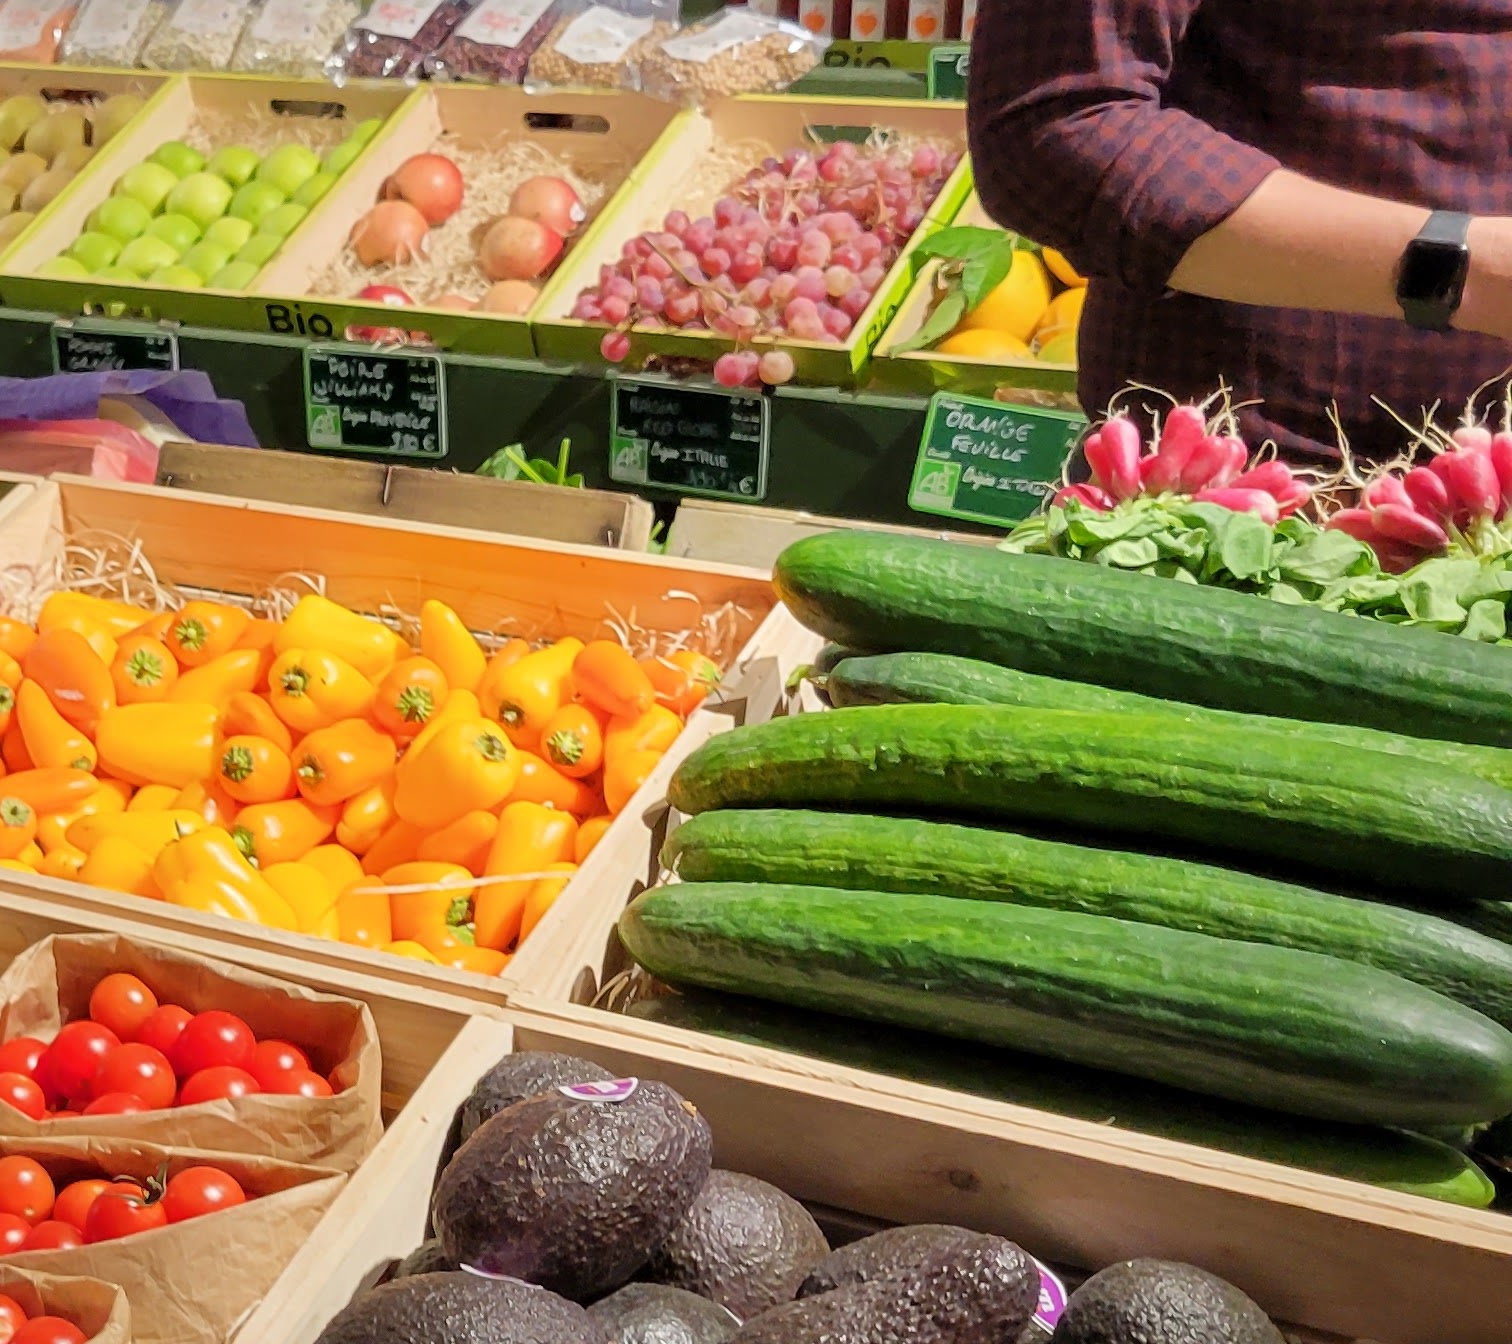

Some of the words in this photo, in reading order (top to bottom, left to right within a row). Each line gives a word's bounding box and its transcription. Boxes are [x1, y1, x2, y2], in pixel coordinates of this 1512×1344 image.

[265, 303, 333, 336] Bio
[946, 410, 1036, 443] ORANGE
[952, 434, 1030, 463] FEUILLE
